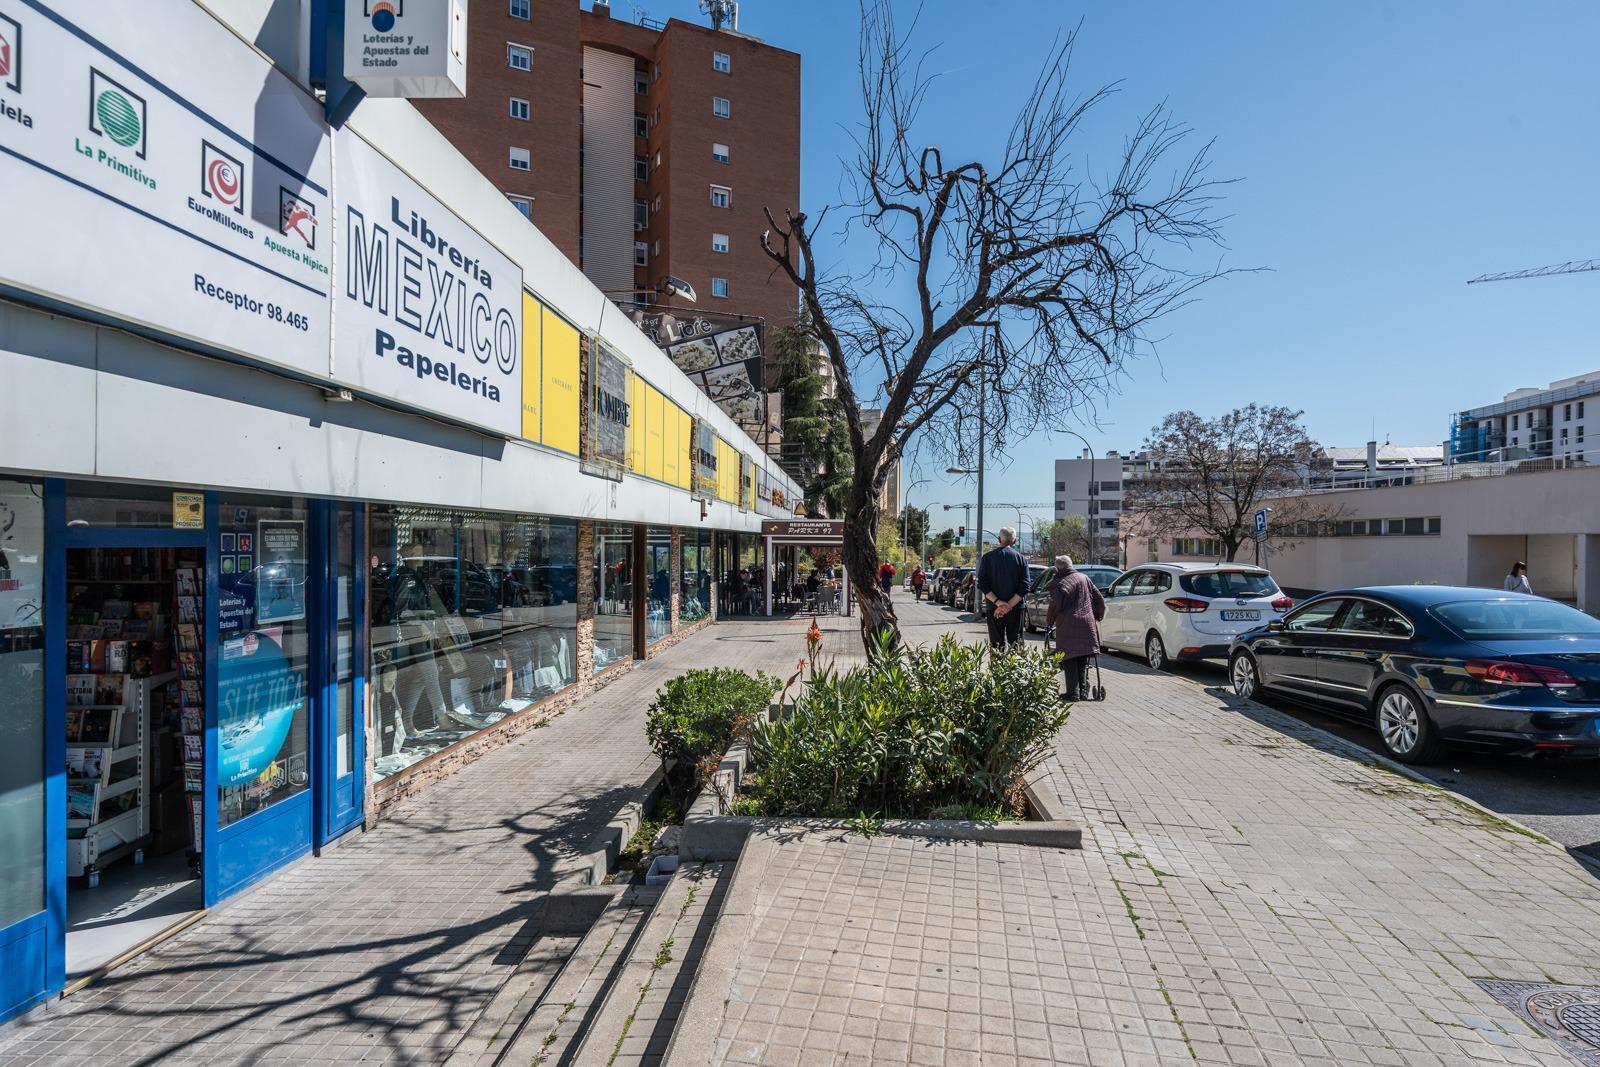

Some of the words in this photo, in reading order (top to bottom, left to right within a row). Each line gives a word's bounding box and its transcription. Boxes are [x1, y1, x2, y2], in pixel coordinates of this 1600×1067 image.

[363, 34, 404, 43] Loterías
[407, 36, 414, 45] y
[363, 46, 410, 57] Apuestas
[413, 46, 429, 55] del
[362, 58, 398, 67] Estado
[75, 138, 94, 158] La
[98, 151, 157, 190] Primitiva
[188, 197, 254, 240] EuroMillones
[264, 236, 301, 262] Apuesta
[391, 195, 492, 290] Librería
[194, 273, 264, 315] Receptor
[267, 303, 309, 332] 98.465
[347, 204, 517, 376] MEXICO
[666, 319, 712, 342] Libre
[375, 328, 500, 402] Papelería
[220, 609, 244, 619] Apuestas
[245, 607, 254, 615] del
[220, 621, 238, 629] Estado
[268, 673, 302, 711] TOCA
